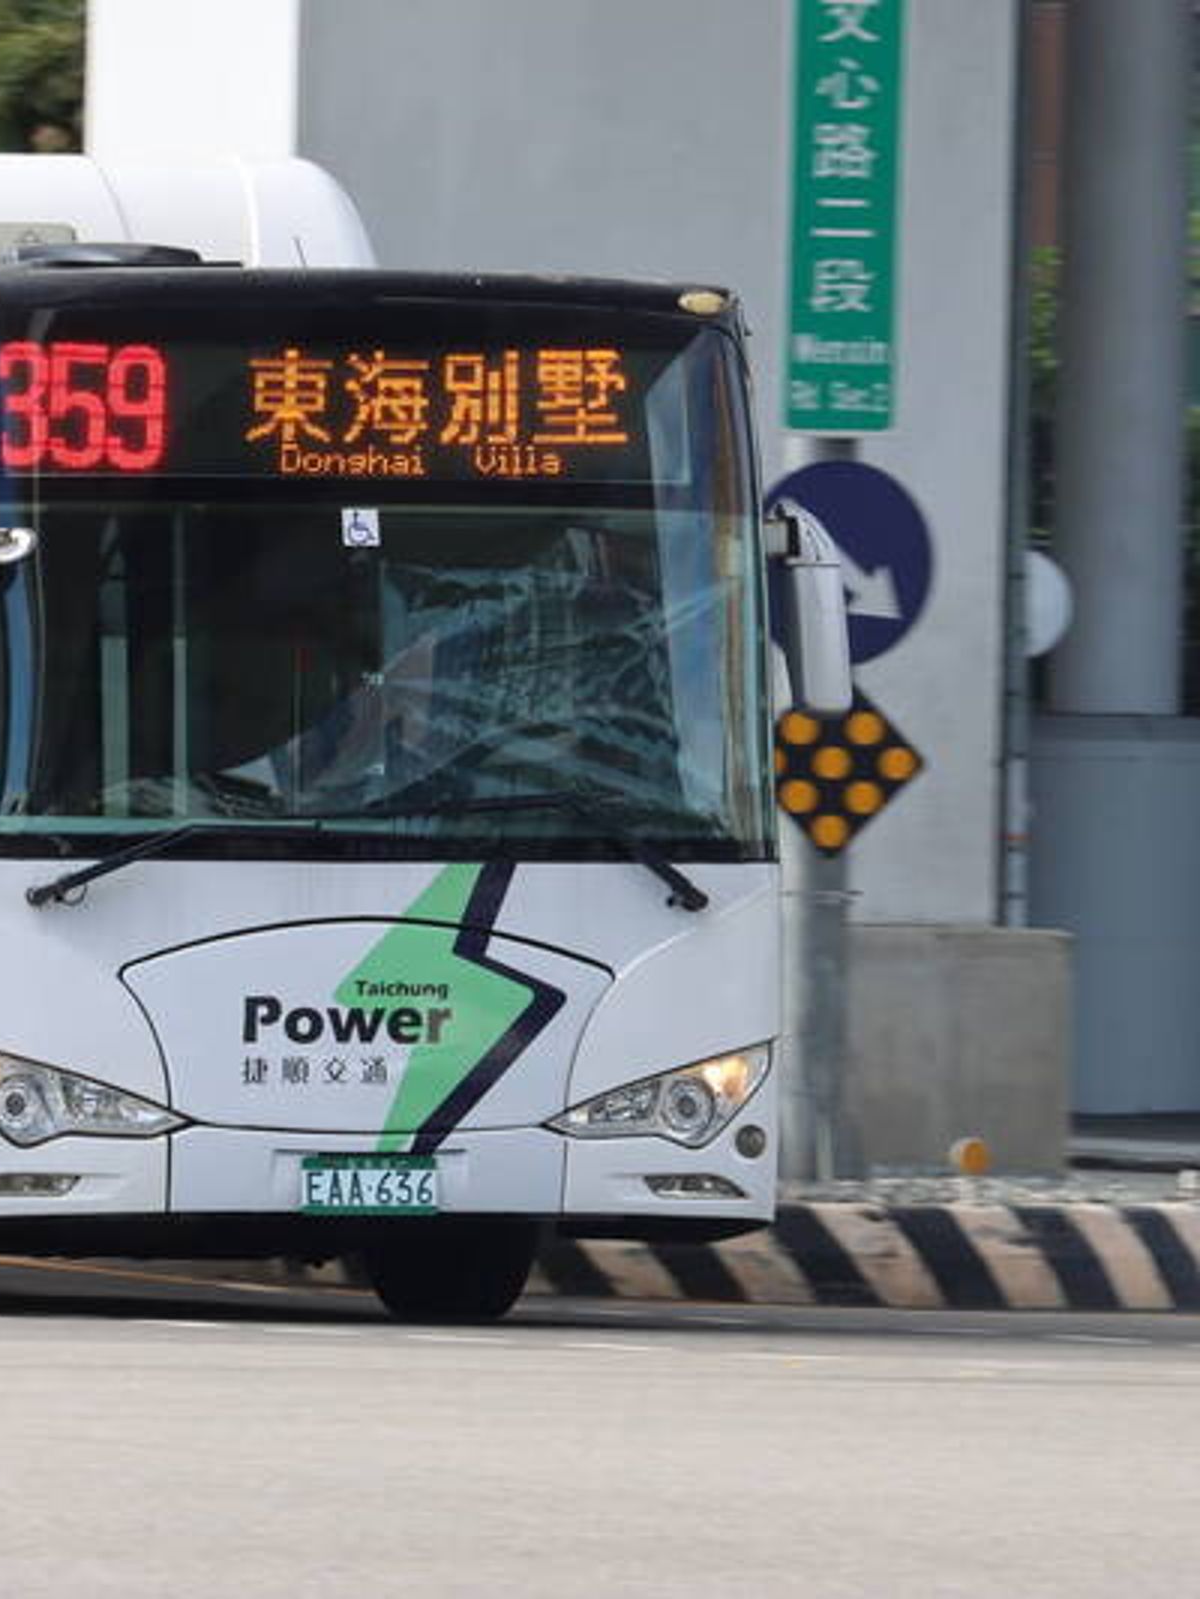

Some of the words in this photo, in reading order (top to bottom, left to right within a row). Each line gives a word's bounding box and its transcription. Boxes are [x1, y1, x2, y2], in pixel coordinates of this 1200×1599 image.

[245, 348, 629, 446] 東海別墅
[280, 445, 424, 477] Donghai
[474, 446, 562, 476] Villa
[355, 980, 449, 1000] Taichung
[243, 995, 453, 1044] Power
[242, 1055, 388, 1085] 捷順交通
